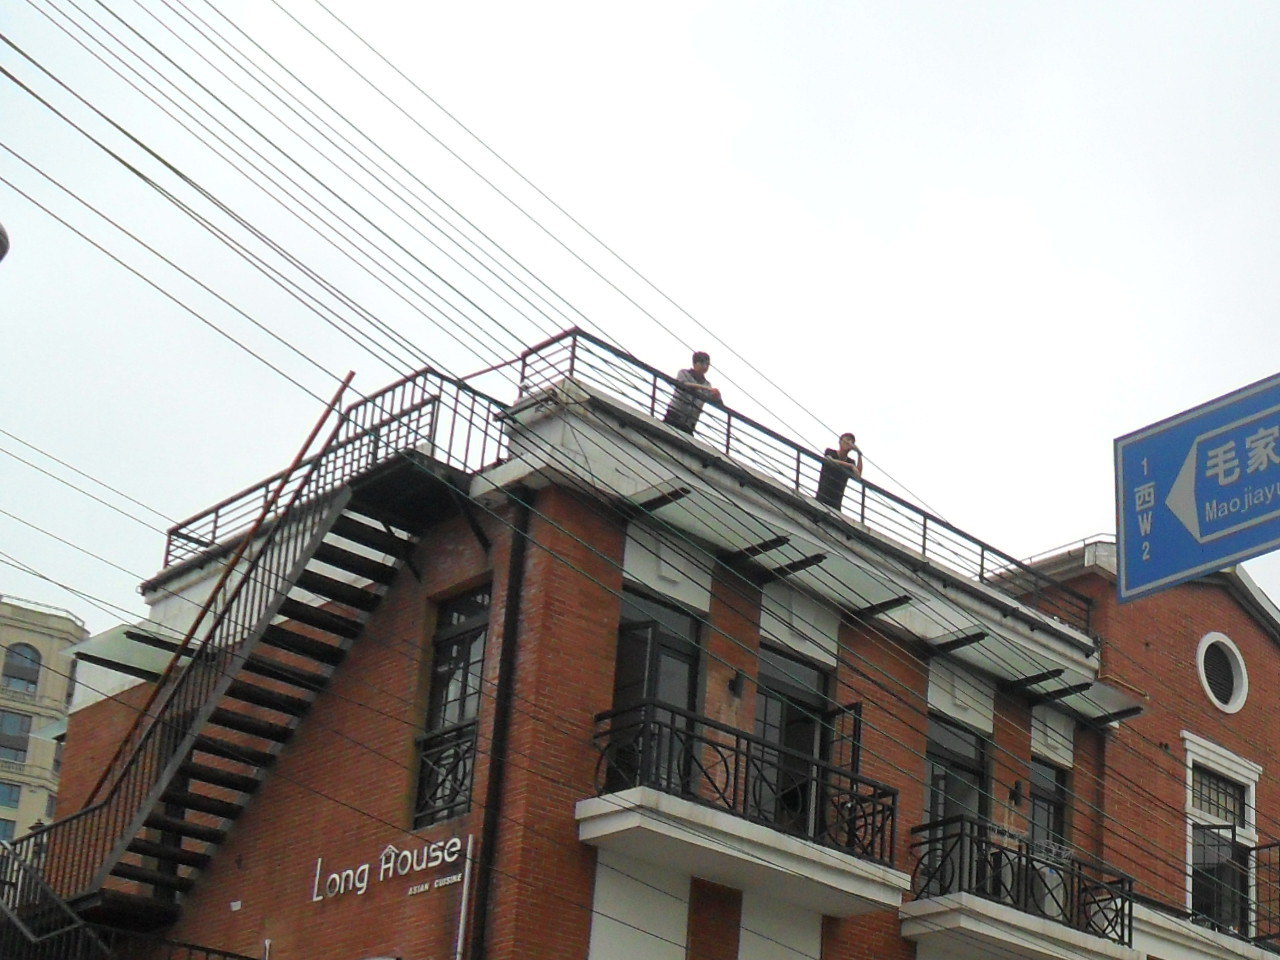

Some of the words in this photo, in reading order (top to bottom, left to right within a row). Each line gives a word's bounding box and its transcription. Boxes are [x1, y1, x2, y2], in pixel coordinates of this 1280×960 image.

[1141, 457, 1149, 476] 1
[1135, 481, 1155, 512] 西
[1138, 513, 1153, 537] W
[1141, 541, 1151, 560] 2
[312, 857, 370, 902] Long
[379, 837, 462, 882] House
